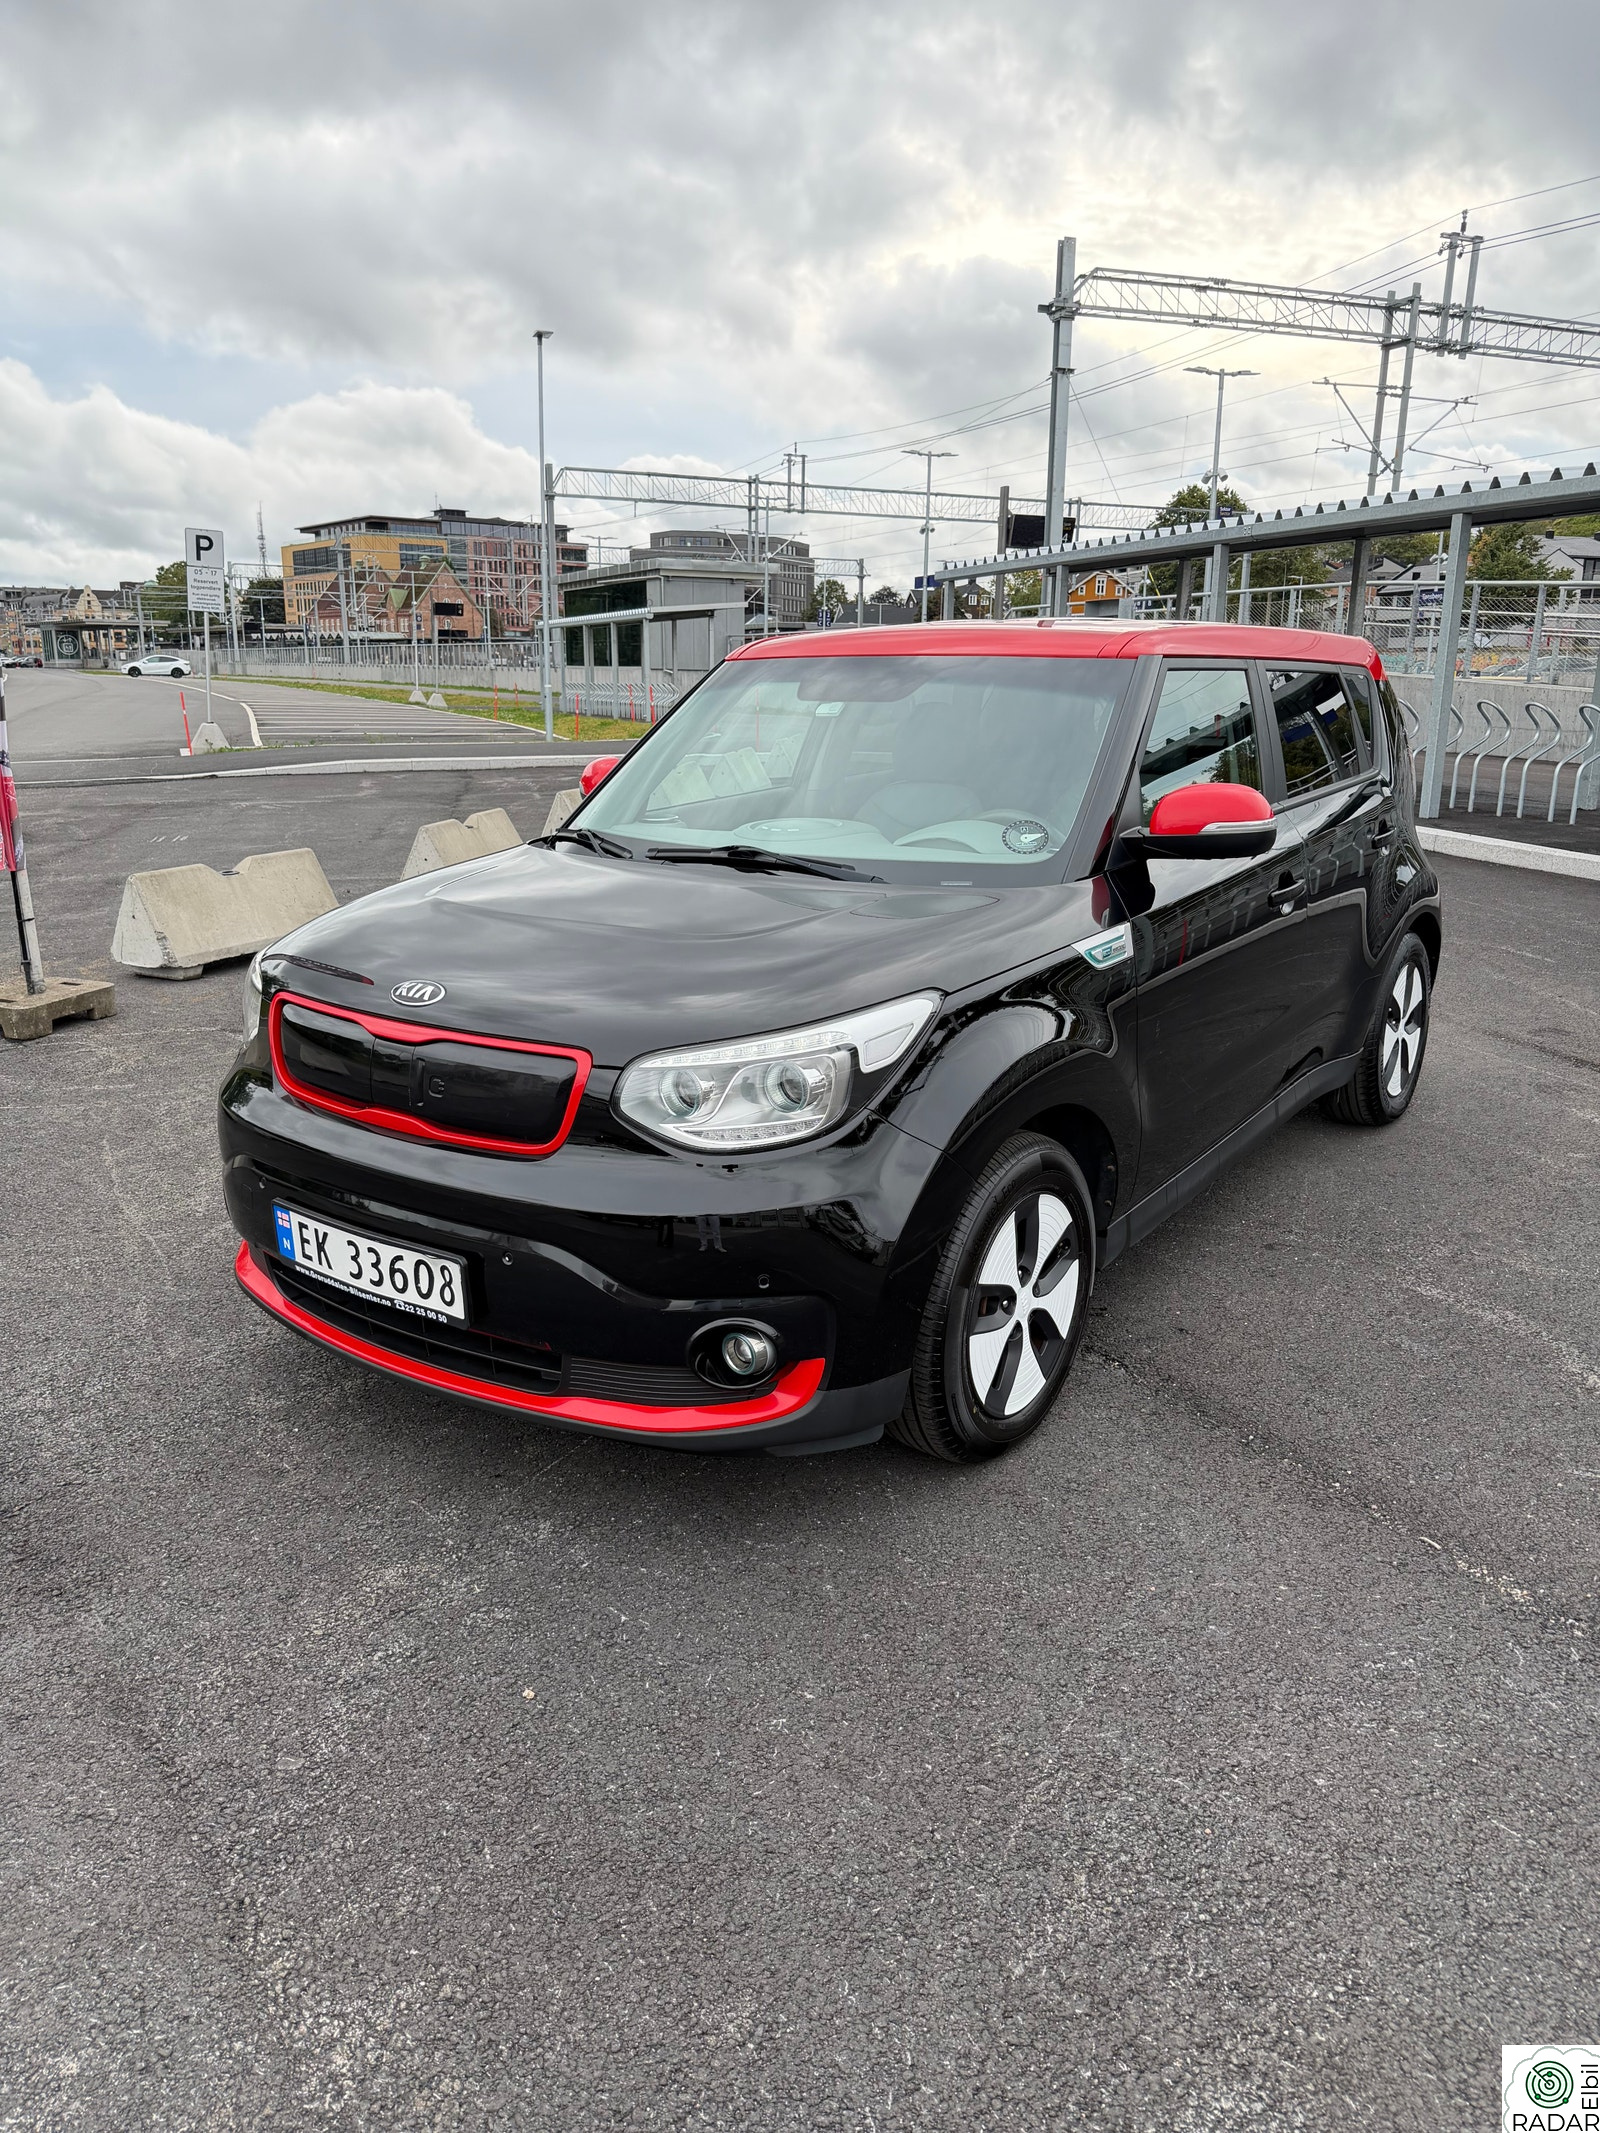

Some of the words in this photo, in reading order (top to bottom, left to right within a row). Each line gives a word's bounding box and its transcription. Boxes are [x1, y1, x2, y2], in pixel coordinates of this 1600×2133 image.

[195, 534, 214, 561] P
[194, 568, 203, 576] 05
[395, 982, 434, 1001] KIA
[282, 1238, 291, 1251] N
[297, 1221, 333, 1271] EK
[346, 1240, 455, 1307] 33608
[416, 1306, 426, 1317] 25
[426, 1310, 437, 1320] 00
[437, 1313, 448, 1324] 50
